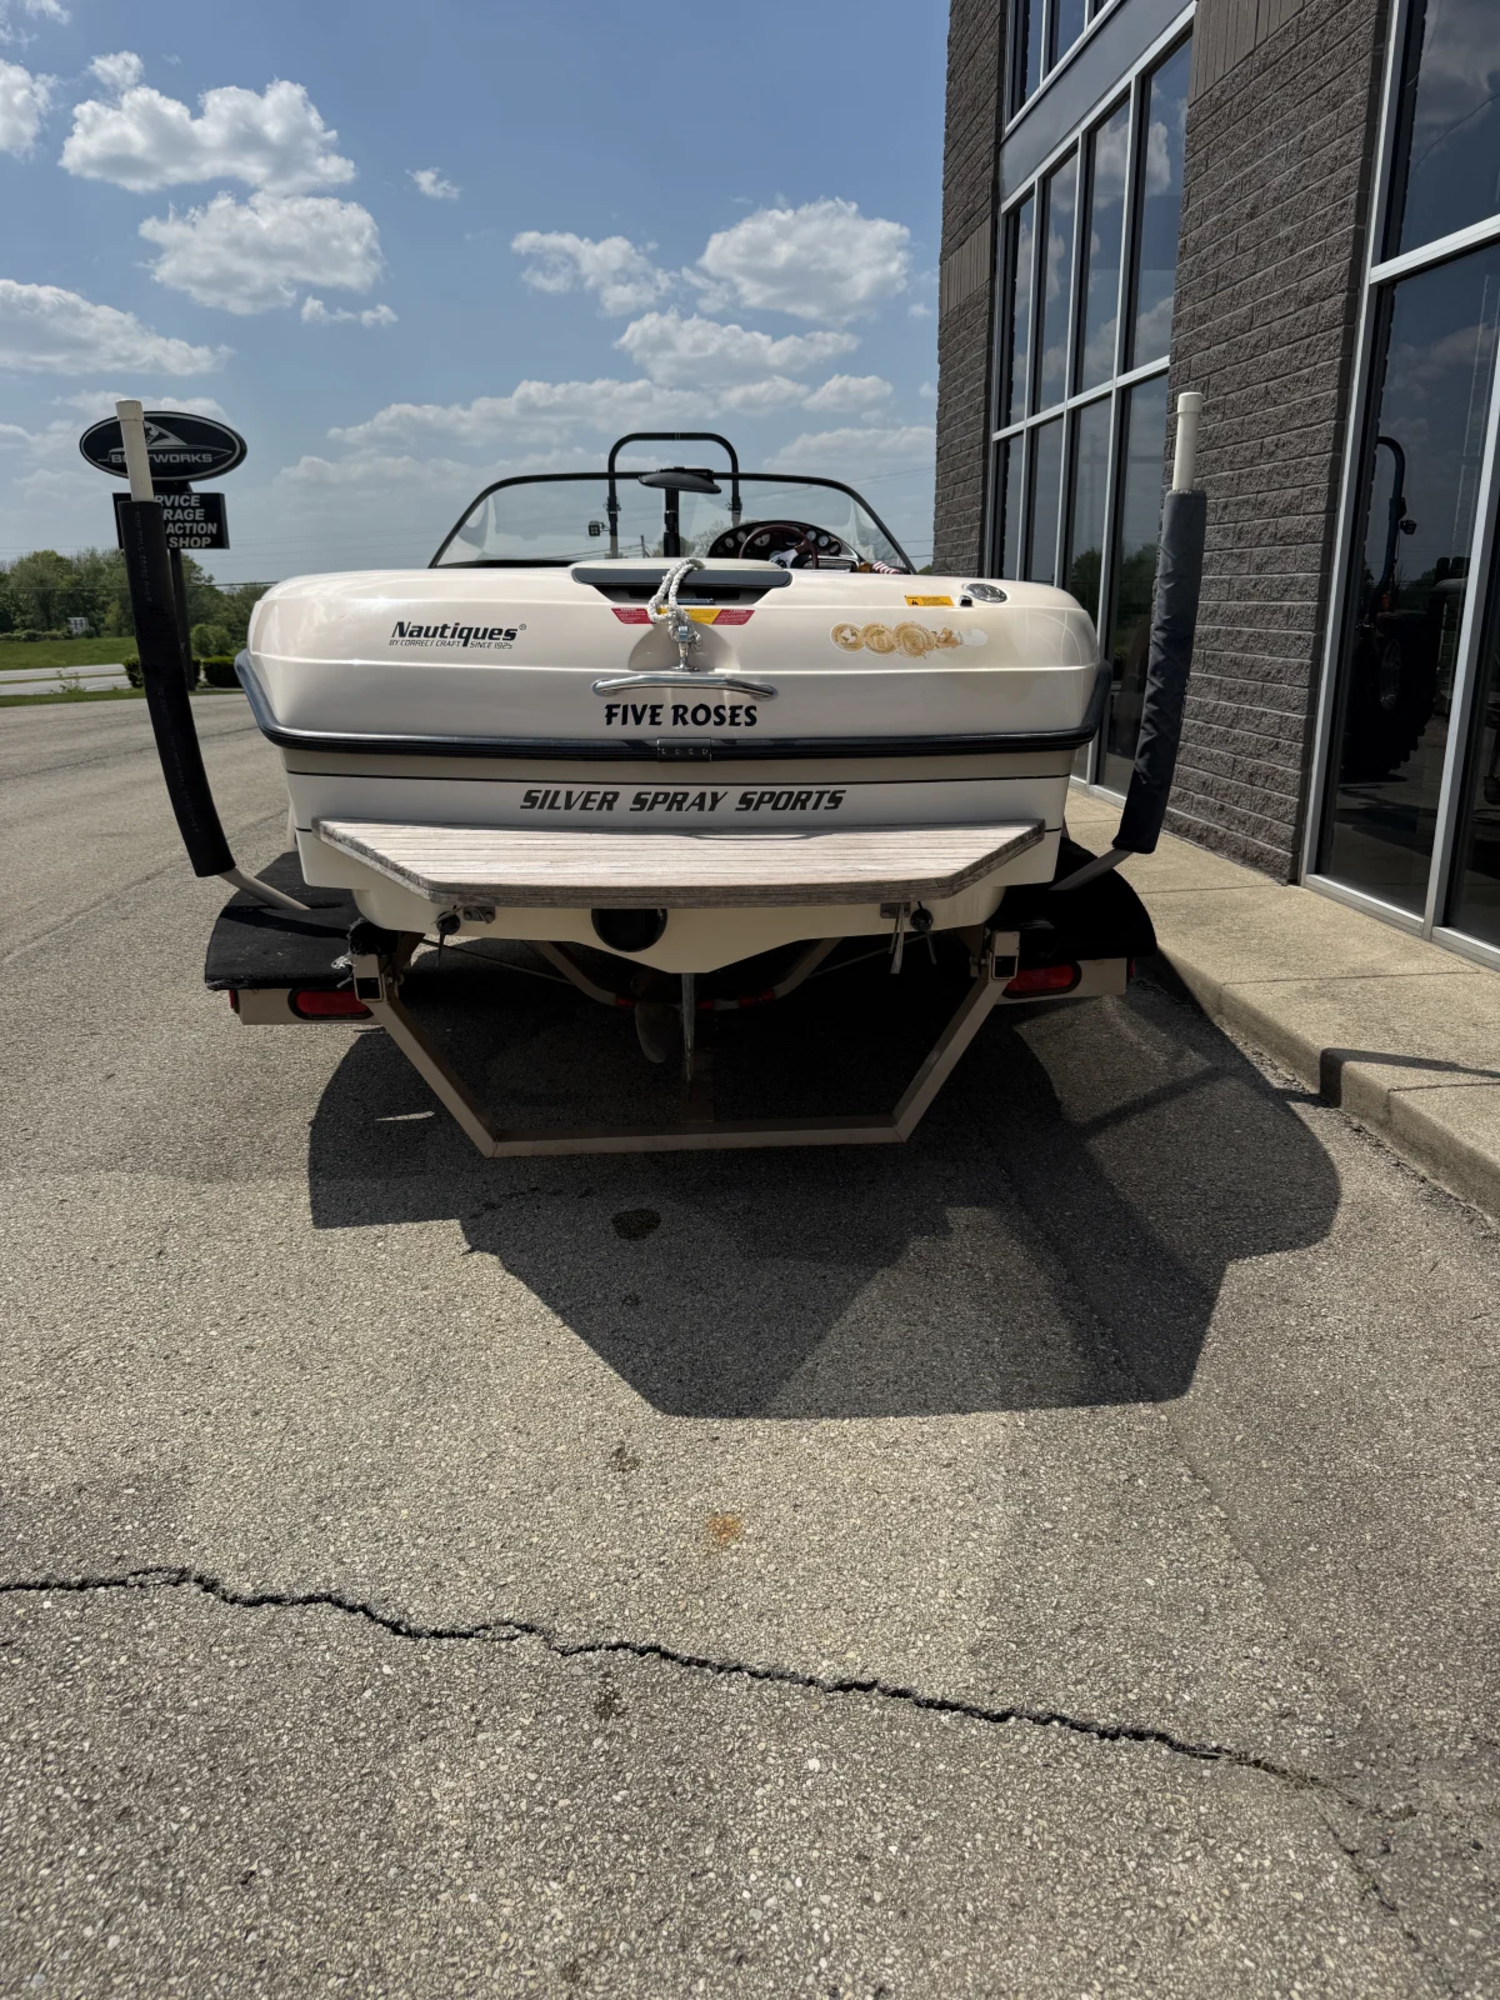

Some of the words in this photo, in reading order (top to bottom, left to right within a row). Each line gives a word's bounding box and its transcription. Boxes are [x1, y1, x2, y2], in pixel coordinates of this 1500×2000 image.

[111, 453, 213, 463] BWORKS
[154, 495, 200, 507] RVICE
[163, 509, 205, 521] RAGE
[168, 536, 211, 548] SHOP
[400, 639, 433, 647] CORRECT
[469, 640, 492, 649] SINCE
[605, 704, 664, 726] FIVE
[671, 704, 758, 727] ROSES
[520, 789, 620, 811] SILVER
[629, 791, 729, 812] SPRAY
[735, 789, 847, 811] SPORTS
